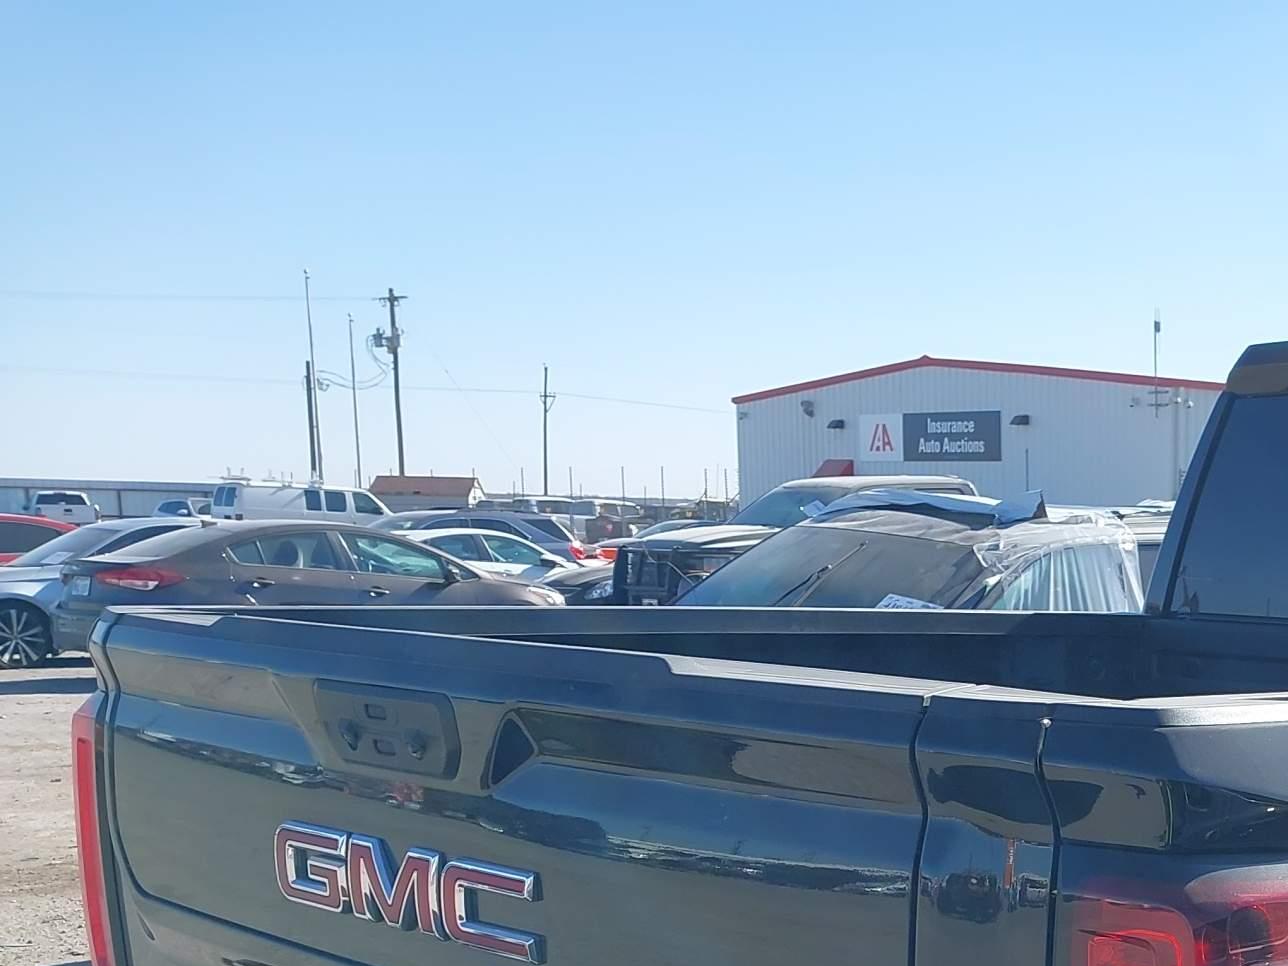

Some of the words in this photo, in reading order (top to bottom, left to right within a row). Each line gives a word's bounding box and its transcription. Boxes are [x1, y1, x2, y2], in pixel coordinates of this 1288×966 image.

[926, 417, 976, 434] Insurance
[918, 437, 942, 454] Auto
[942, 436, 985, 454] Auctions
[273, 818, 548, 966] GMC
